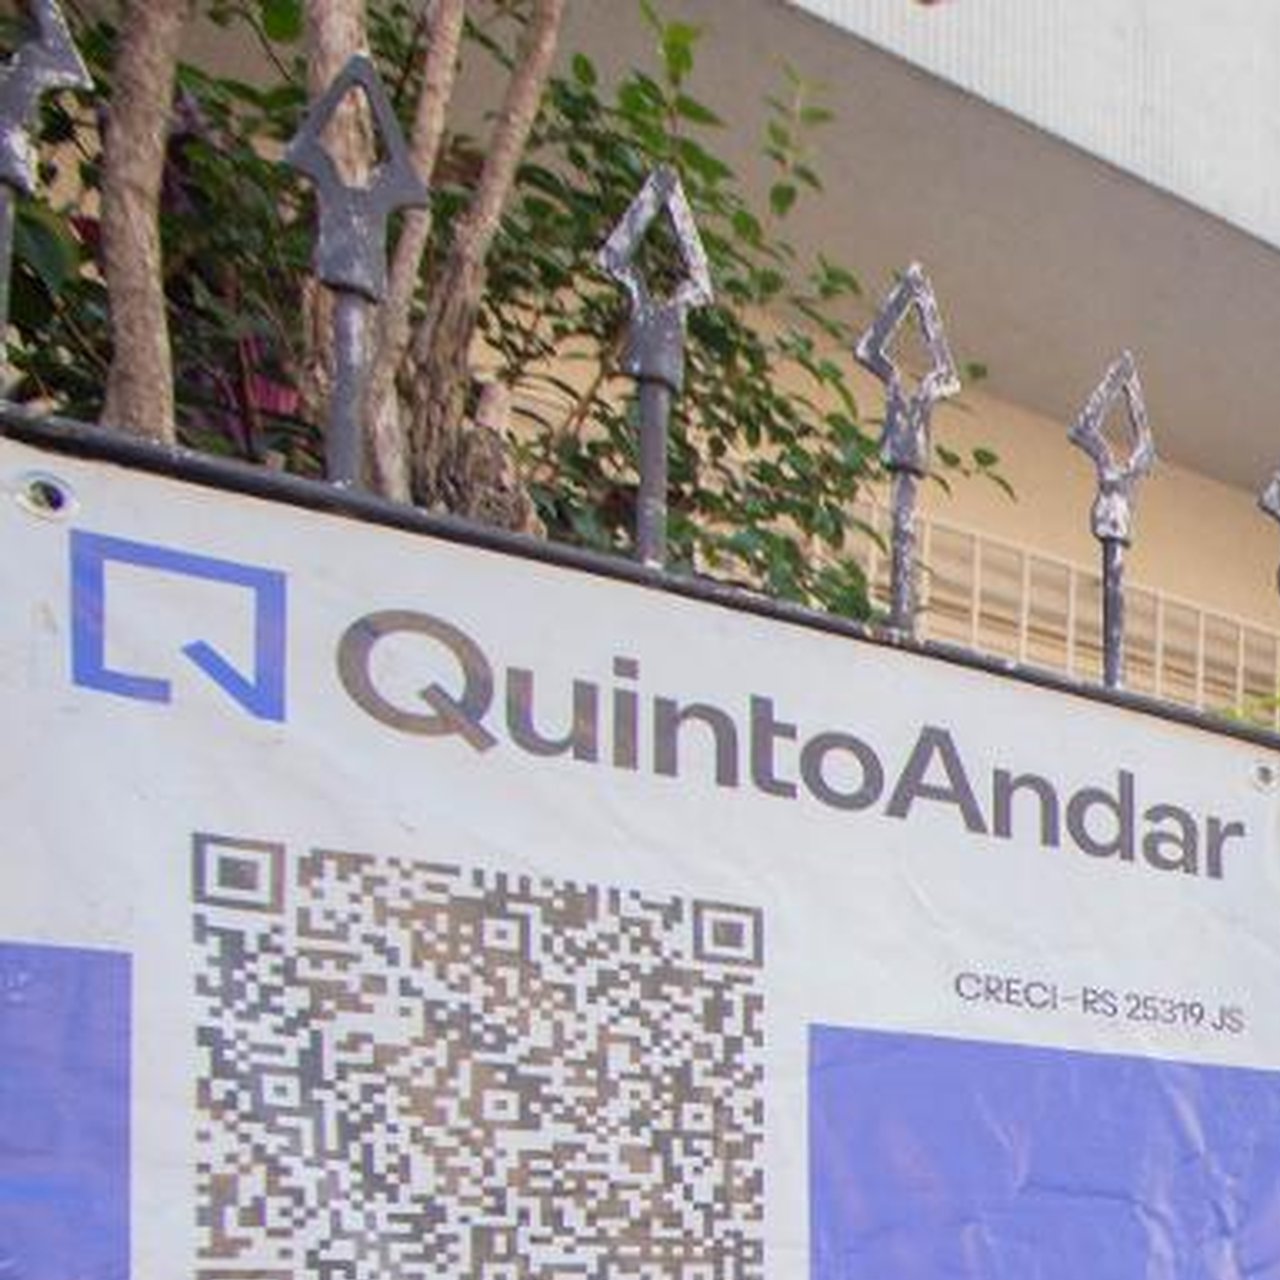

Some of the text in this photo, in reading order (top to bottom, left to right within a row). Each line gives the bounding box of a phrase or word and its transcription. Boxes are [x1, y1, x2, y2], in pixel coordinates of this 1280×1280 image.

[336, 609, 1246, 880] QuintoAndar
[1124, 993, 1206, 1027] 25319
[1210, 1005, 1245, 1034] JS
